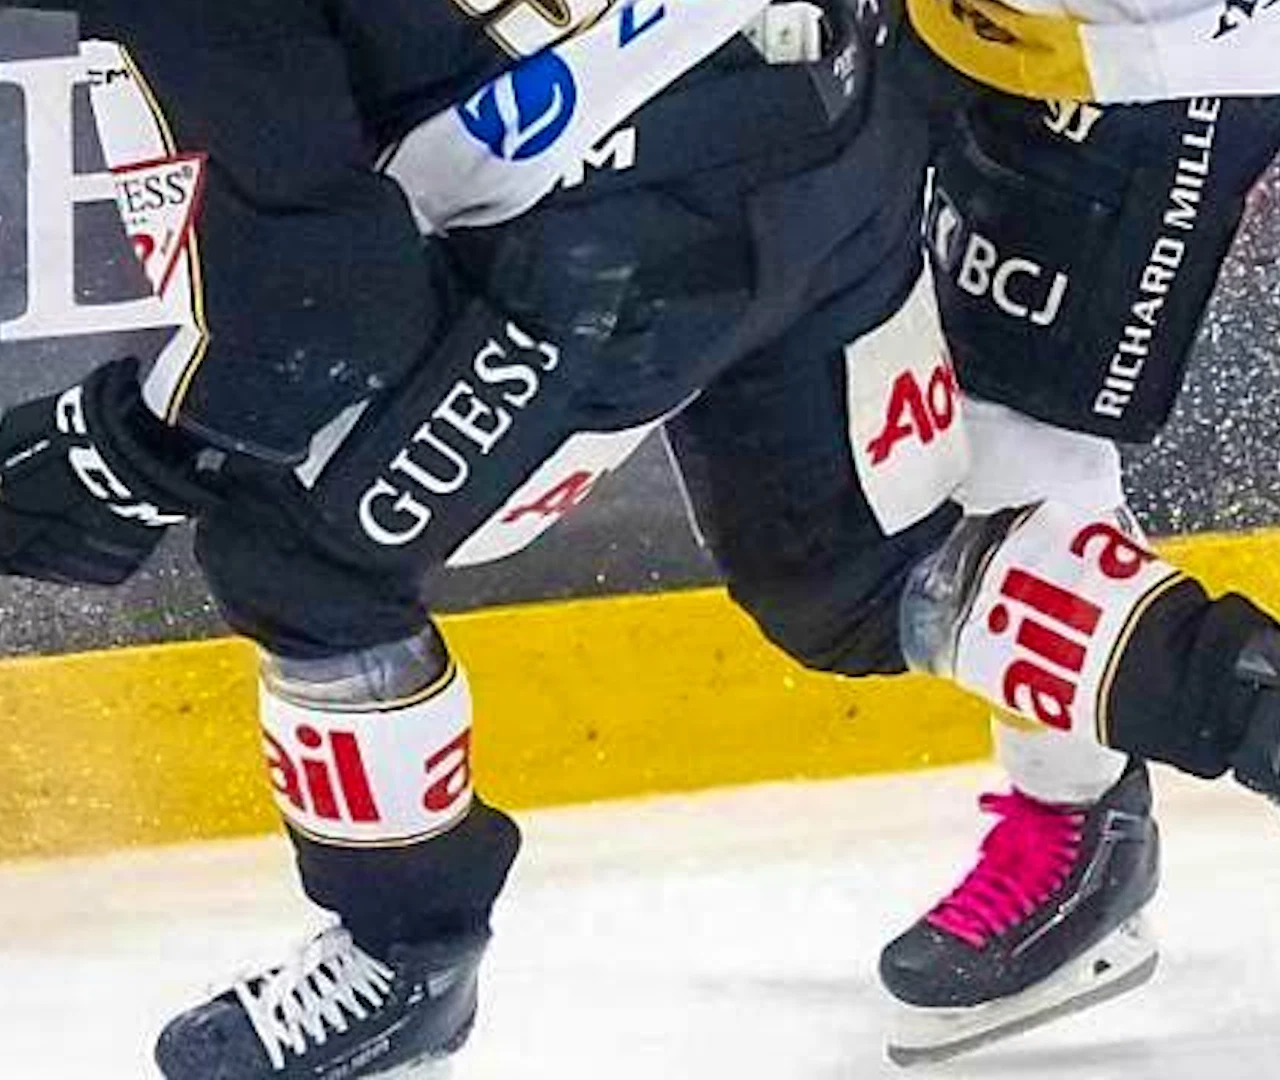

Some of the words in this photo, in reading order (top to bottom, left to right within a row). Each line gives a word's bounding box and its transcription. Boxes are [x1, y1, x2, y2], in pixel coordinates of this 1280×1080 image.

[120, 172, 187, 213] ESS
[956, 232, 1069, 327] BCJ
[1093, 233, 1187, 420] RICHARD
[987, 567, 1103, 732] ail
